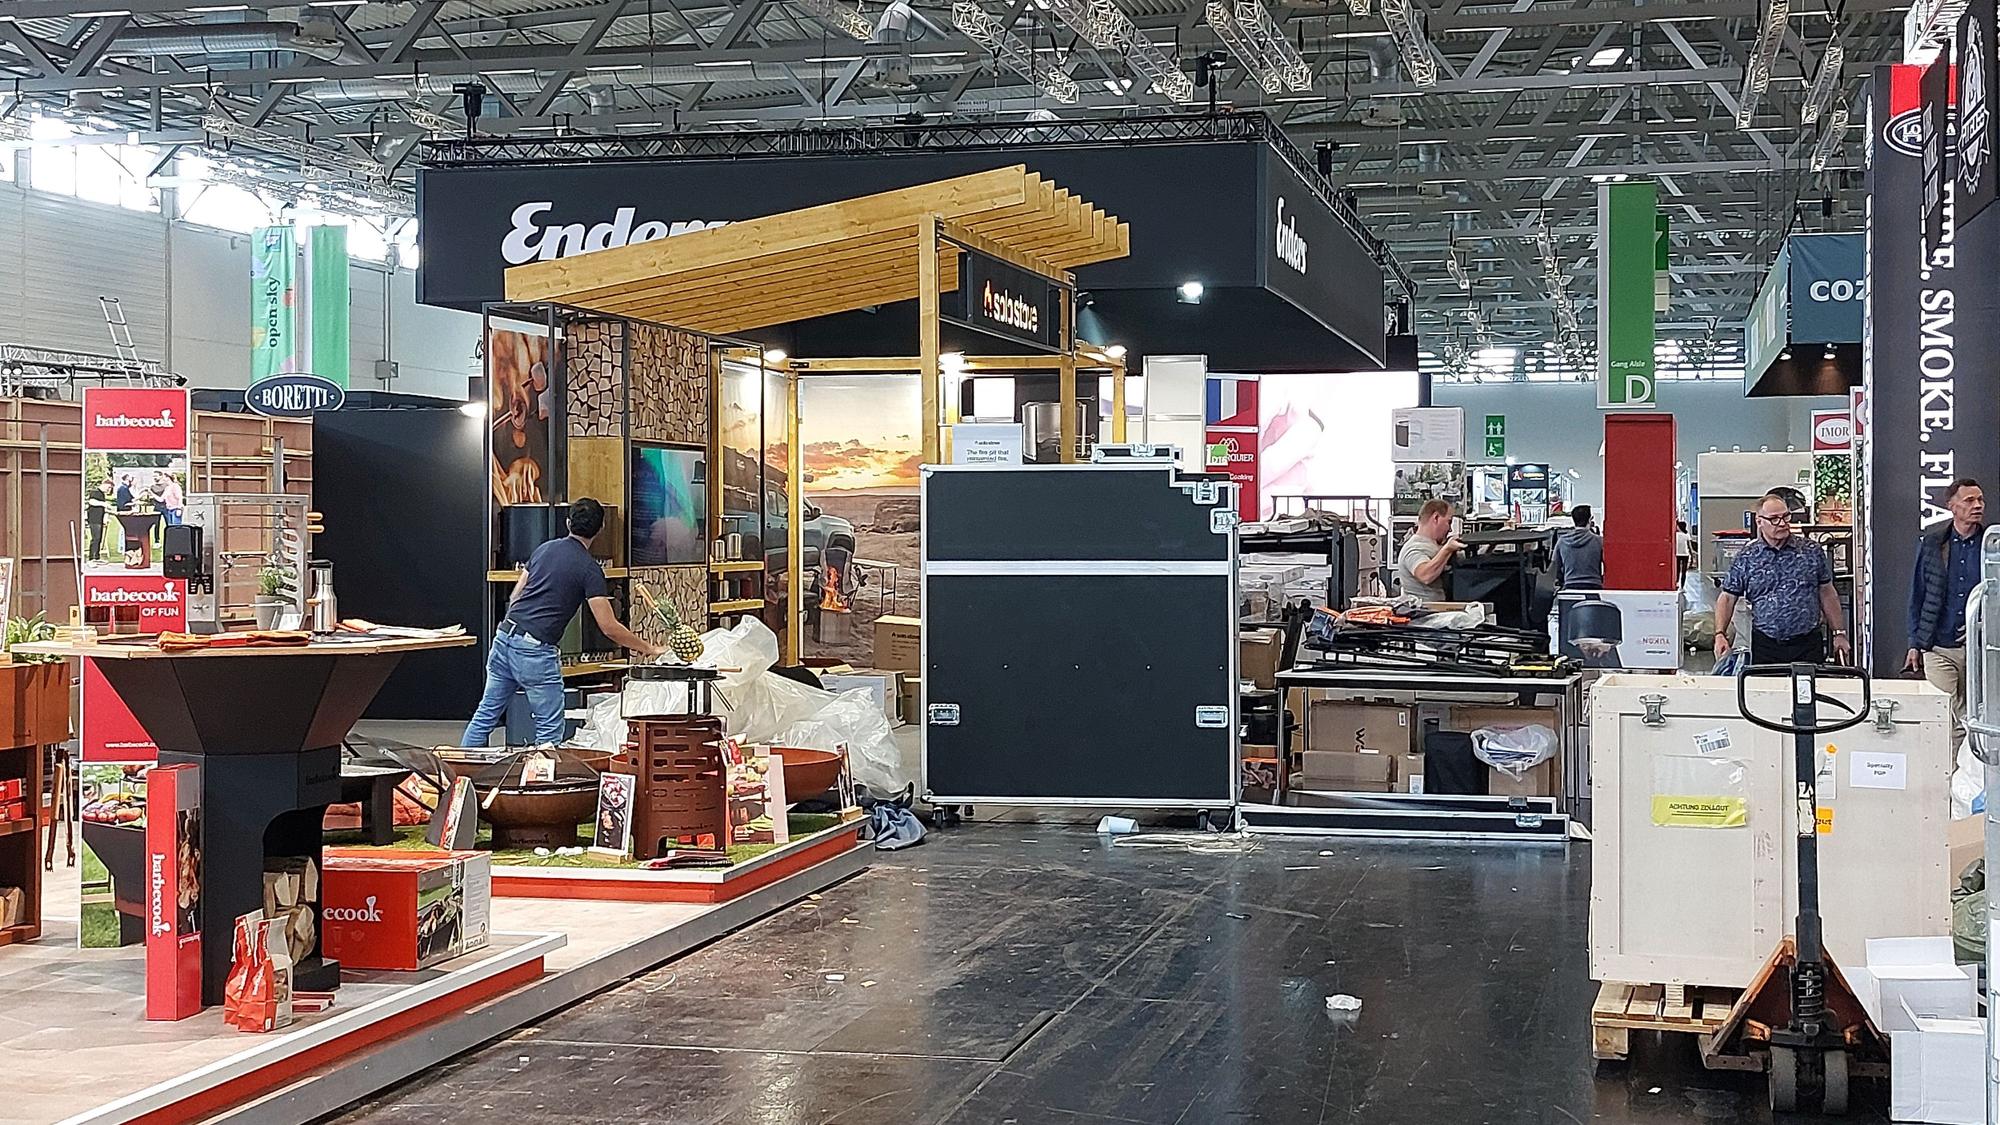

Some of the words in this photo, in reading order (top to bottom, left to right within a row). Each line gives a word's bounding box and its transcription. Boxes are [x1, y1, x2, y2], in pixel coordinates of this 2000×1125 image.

[501, 201, 739, 265] Ende
[1276, 196, 1308, 275] Enders
[1920, 289, 1955, 442] SMOKE.
[261, 384, 328, 410] BORETTI
[1625, 374, 1652, 403] D
[95, 408, 176, 428] barbecook
[90, 581, 181, 603] barbecook
[142, 607, 157, 617] OF
[157, 606, 179, 617] FUN
[152, 853, 171, 938] barbecook
